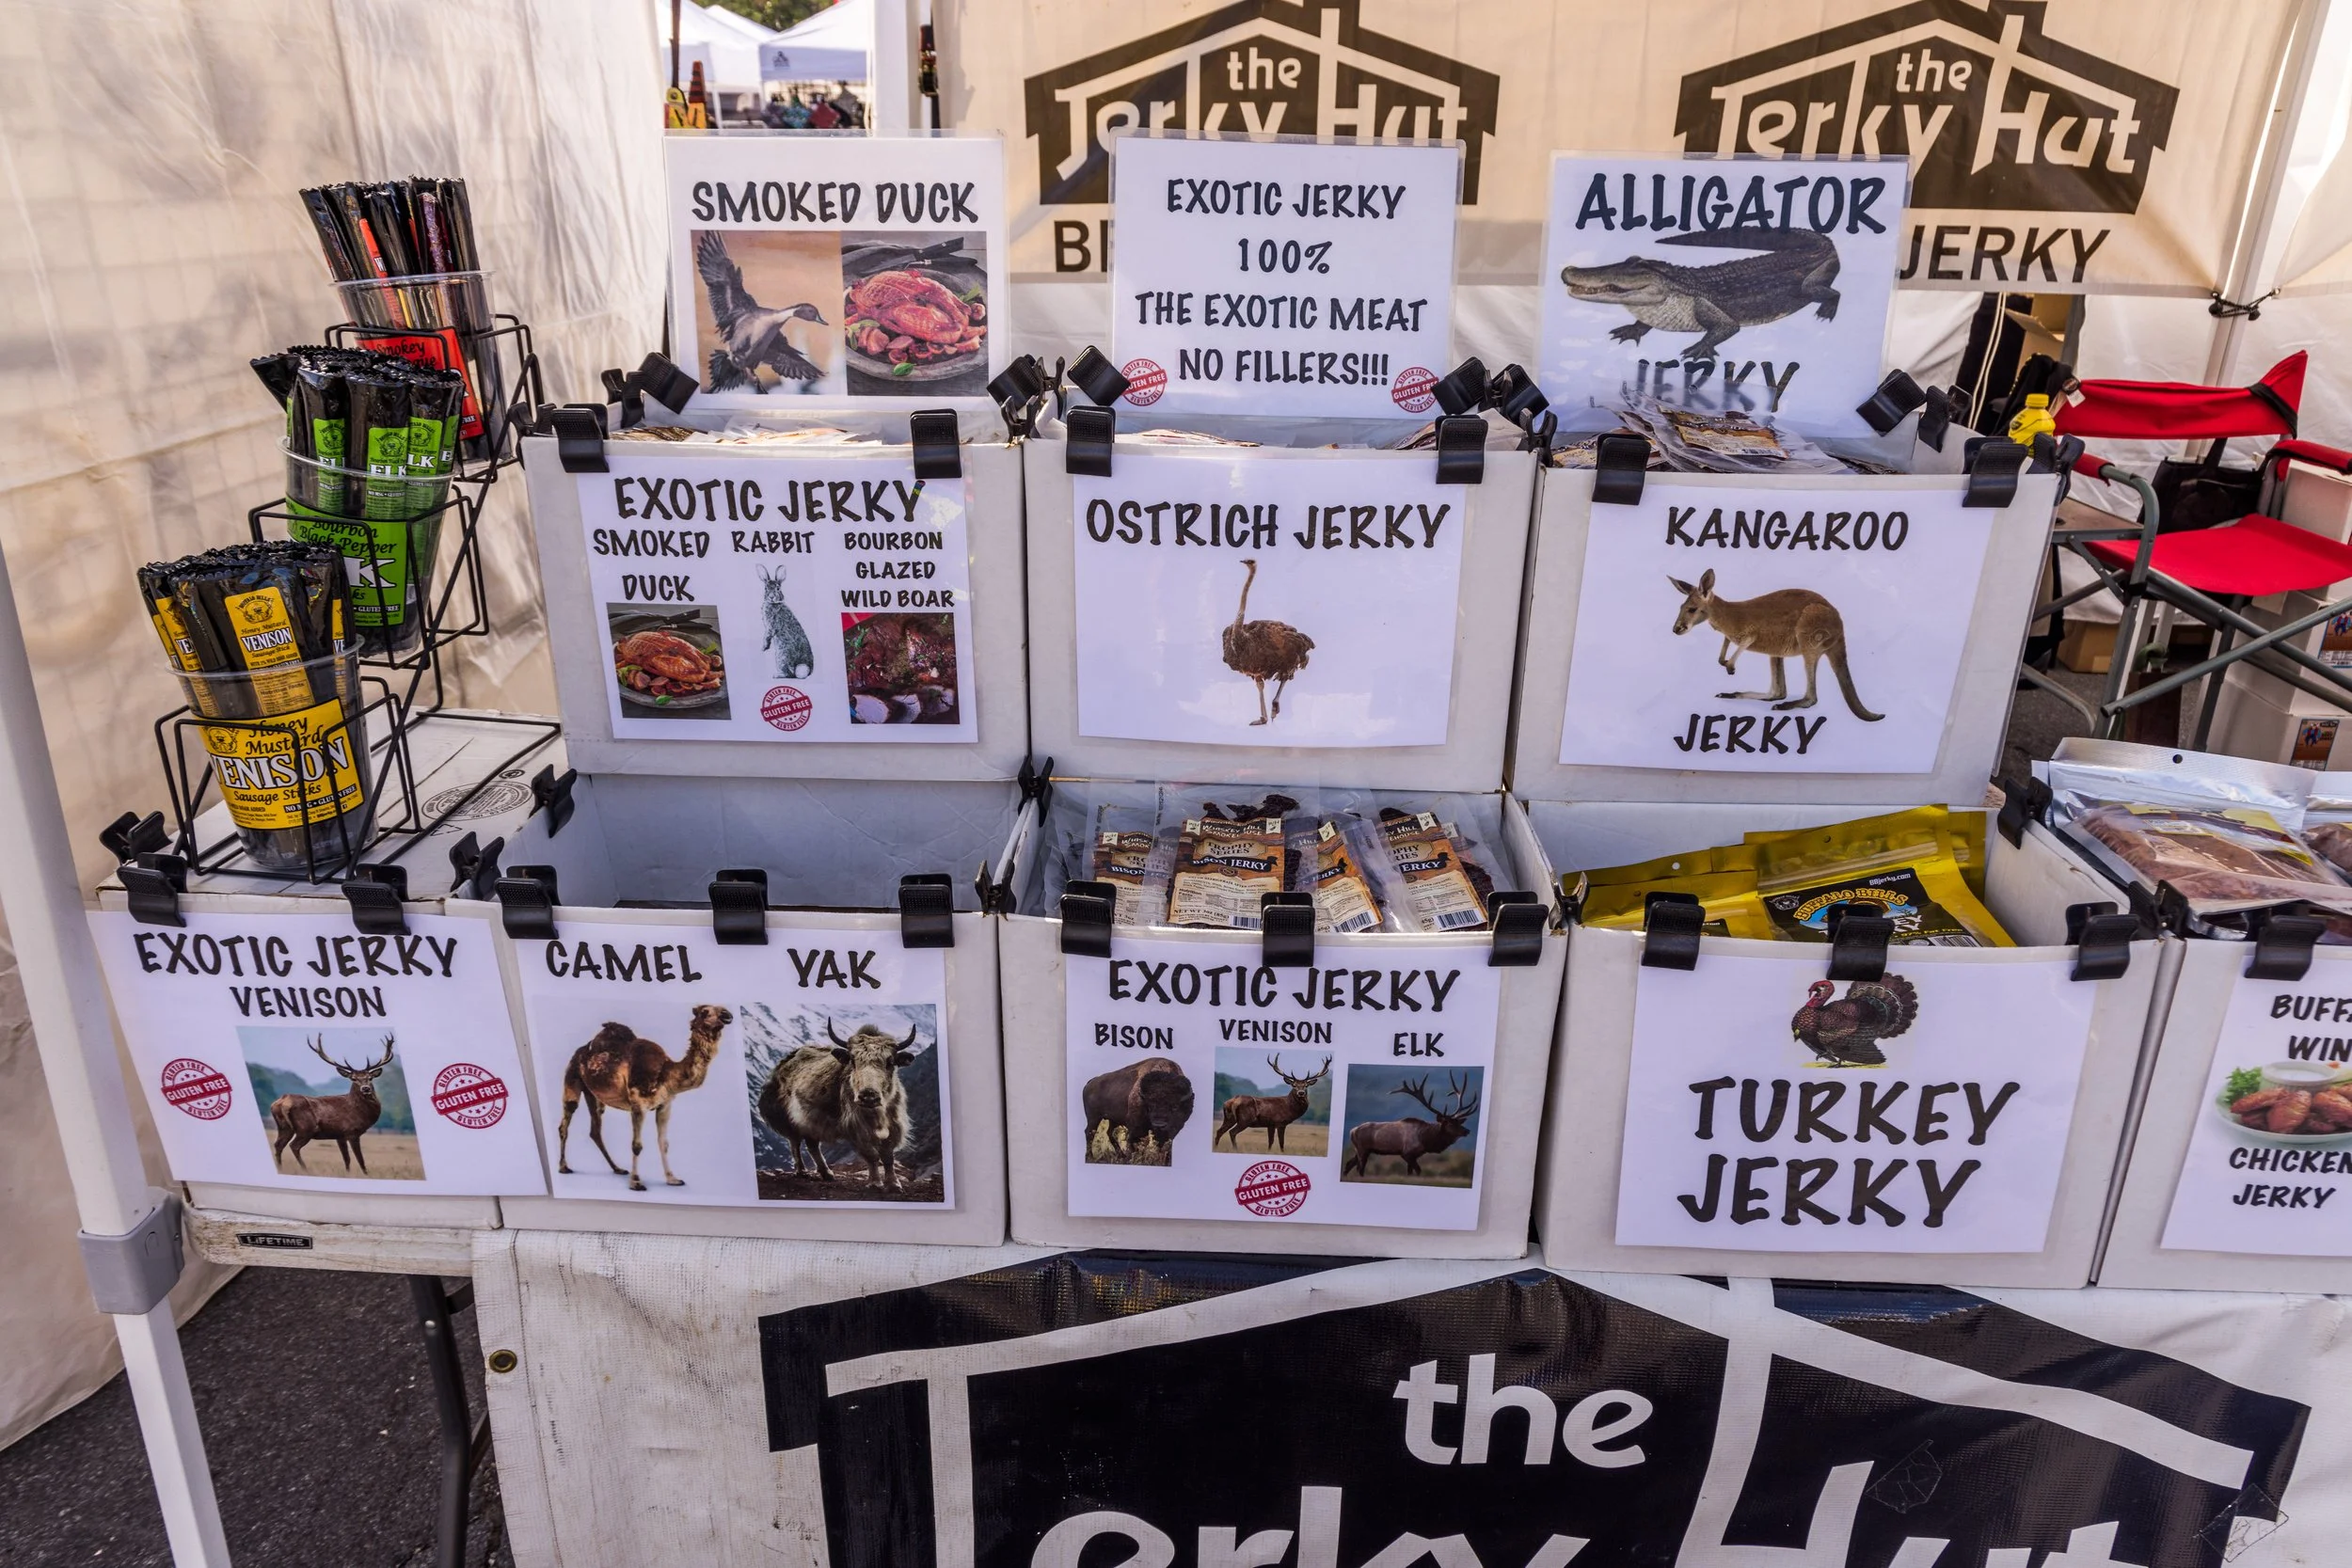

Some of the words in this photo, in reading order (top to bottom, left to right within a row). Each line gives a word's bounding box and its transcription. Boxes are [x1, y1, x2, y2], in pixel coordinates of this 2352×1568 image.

[1227, 47, 1302, 90] the
[1896, 48, 1973, 92] the
[1971, 15, 2141, 175] Hut
[691, 182, 862, 223] SMOKED
[875, 182, 979, 223] DUCK
[1167, 178, 1282, 215] EXOTIC
[1292, 183, 1406, 219] JERKY
[1575, 172, 1887, 234] ALLIGATOR
[1238, 237, 1333, 274] 100%
[1900, 225, 2111, 284] JERKY
[1135, 292, 1194, 325] THE
[1204, 293, 1318, 329] EXOTIC
[1329, 297, 1428, 332] MEAT
[1126, 378, 1147, 391] UTEN
[1149, 372, 1166, 385] FREE
[1179, 348, 1223, 381] NO
[1234, 349, 1389, 386] FILLERS!!!
[1393, 386, 1420, 400] GLUTEN
[1635, 358, 1801, 414] JERKY
[406, 453, 436, 468] LK
[613, 477, 764, 522] EXOTIC
[777, 480, 926, 523] JERKY
[1086, 499, 1279, 549] OSTRICH
[1293, 503, 1451, 549] JERKY
[1665, 506, 1909, 550] KANGAROO
[593, 529, 710, 558] SMOKED
[731, 531, 815, 554] RABBIT
[844, 531, 943, 551] BOURBON
[855, 561, 936, 580] GLAZED
[622, 574, 695, 602] DUCK
[840, 589, 891, 608] WILD
[897, 590, 955, 609] BOAR
[241, 627, 293, 652] VENISON
[763, 705, 791, 719] GLUTEN
[793, 699, 810, 710] FREE
[1673, 713, 1827, 754] JERKY
[233, 790, 278, 805] Sausage
[1207, 841, 1255, 851] TROPHY
[1210, 847, 1250, 856] SERIES
[1230, 859, 1268, 871] JERKY
[1402, 861, 1441, 872] ERKY
[1793, 889, 1855, 921] BUFFALO
[1855, 887, 1910, 905] BILLS
[133, 932, 294, 977] EXOTIC
[307, 935, 458, 978] JERKY
[546, 941, 703, 983] CAMEL
[787, 948, 882, 989] YAK
[1108, 959, 1278, 1007] EXOTIC
[1292, 967, 1461, 1013] JERKY
[229, 986, 387, 1018] VENISON
[2270, 993, 2352, 1022] BUFF
[1094, 1022, 1174, 1050] BISON
[1219, 1019, 1333, 1044] VENISON
[1392, 1032, 1445, 1057] ELK
[166, 1085, 203, 1101] GLUTEN
[202, 1078, 229, 1091] FREE
[436, 1090, 478, 1110] GLUTEN
[478, 1083, 505, 1098] FREE
[1689, 1075, 2021, 1147] TURKEY
[2229, 1147, 2352, 1175] CHICKEN
[1238, 1186, 1279, 1201] GLUTEN
[1282, 1178, 1308, 1191] FREE
[1677, 1153, 1981, 1228] JERKY
[2233, 1183, 2336, 1210] JERKY
[1393, 1353, 1653, 1469] the
